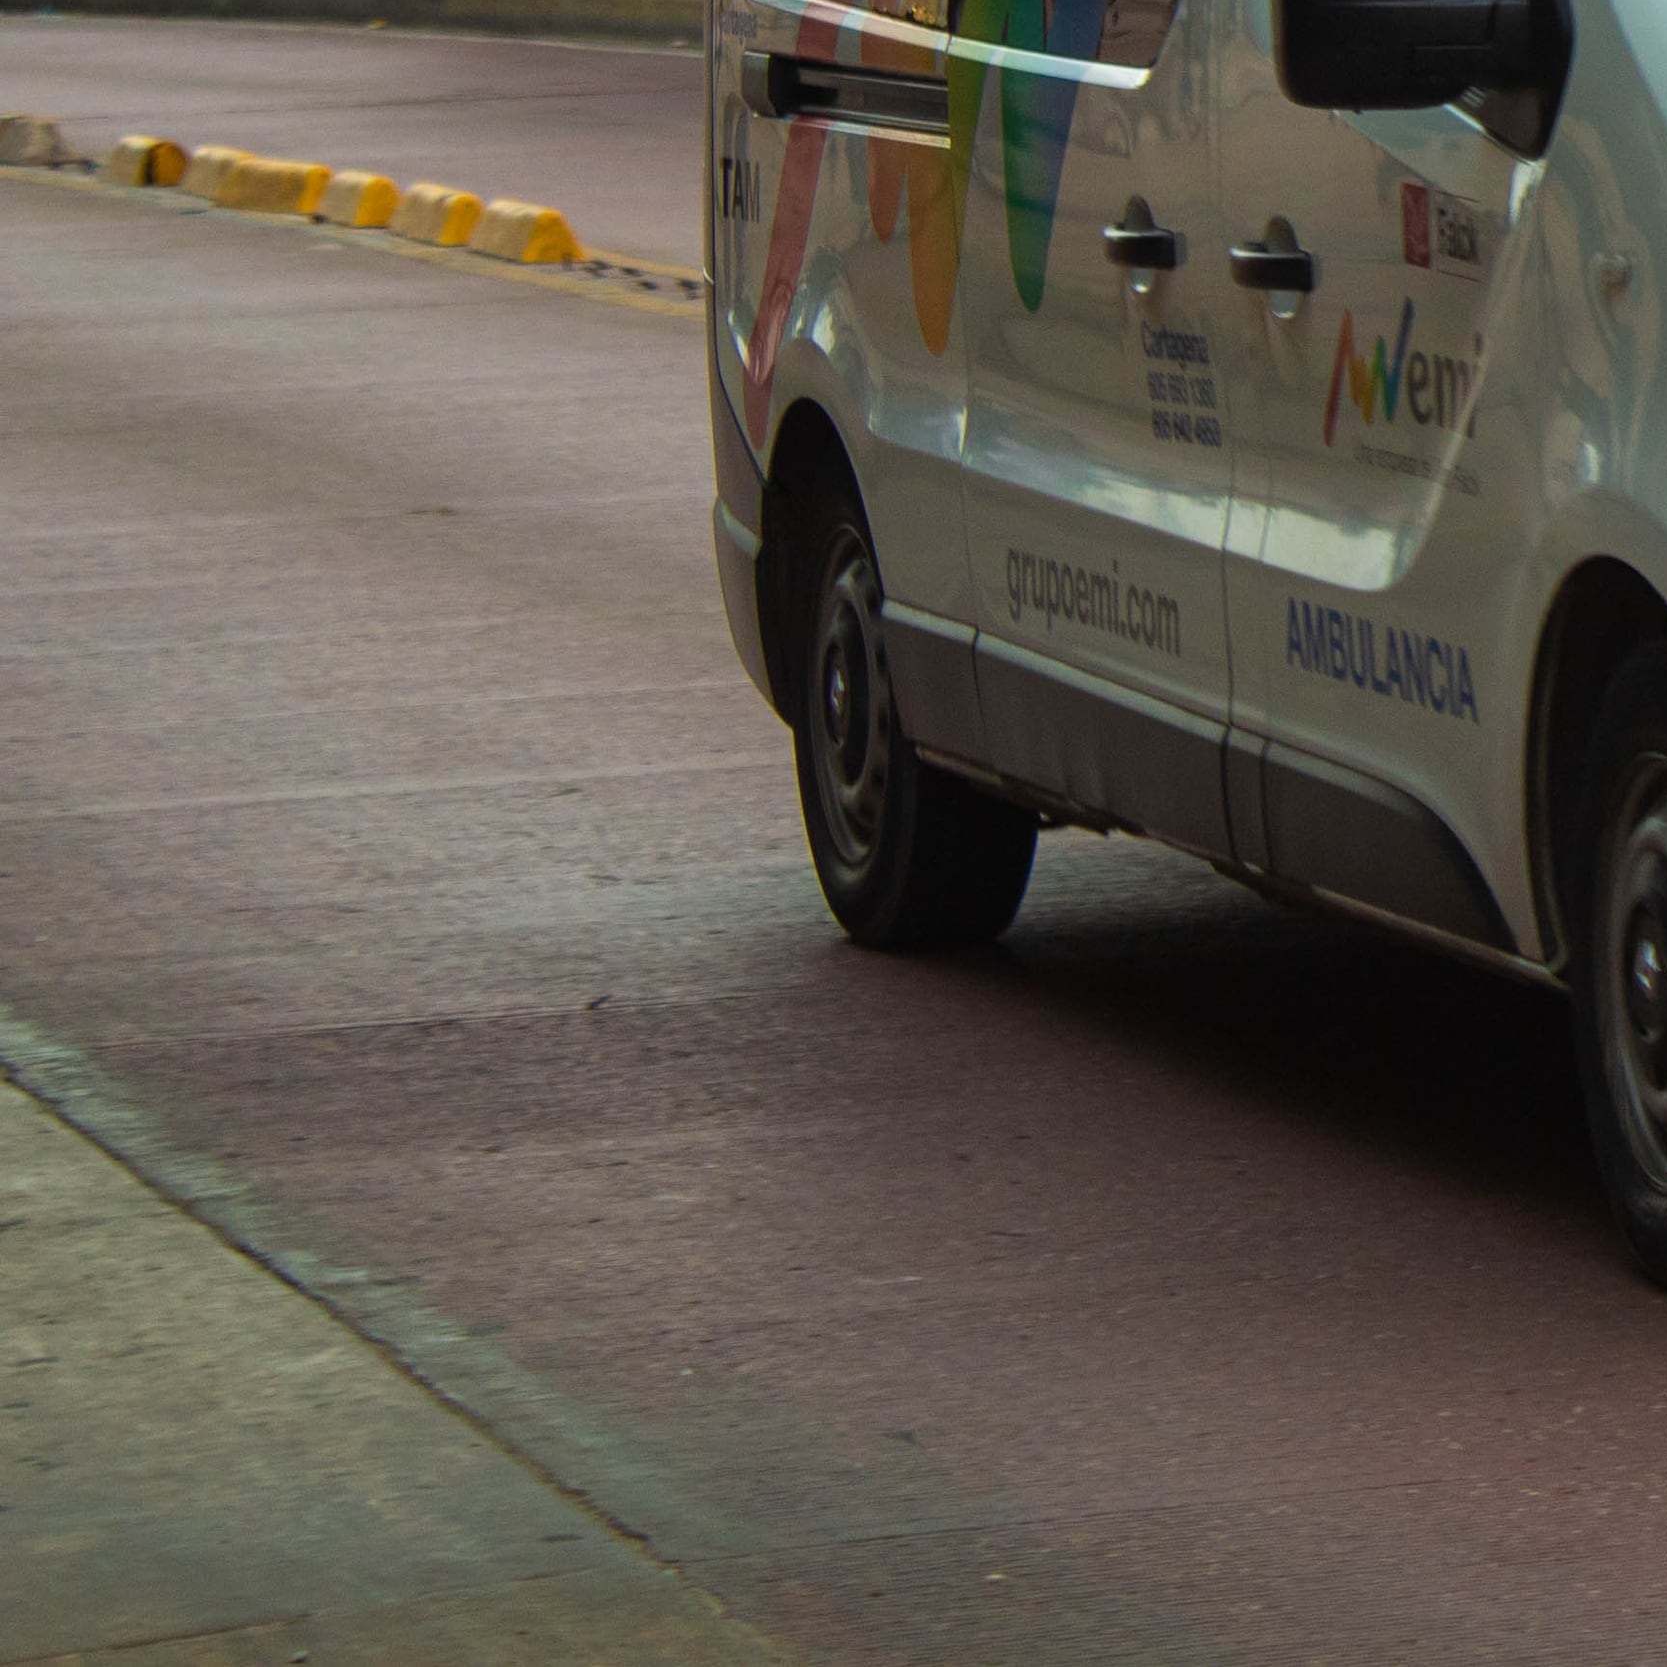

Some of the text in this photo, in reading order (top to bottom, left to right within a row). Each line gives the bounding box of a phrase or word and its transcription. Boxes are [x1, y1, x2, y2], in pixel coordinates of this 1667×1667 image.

[721, 157, 760, 224] TAM
[1006, 546, 1182, 657] grupoemi.com
[1287, 596, 1481, 725] AMBULANCIA
